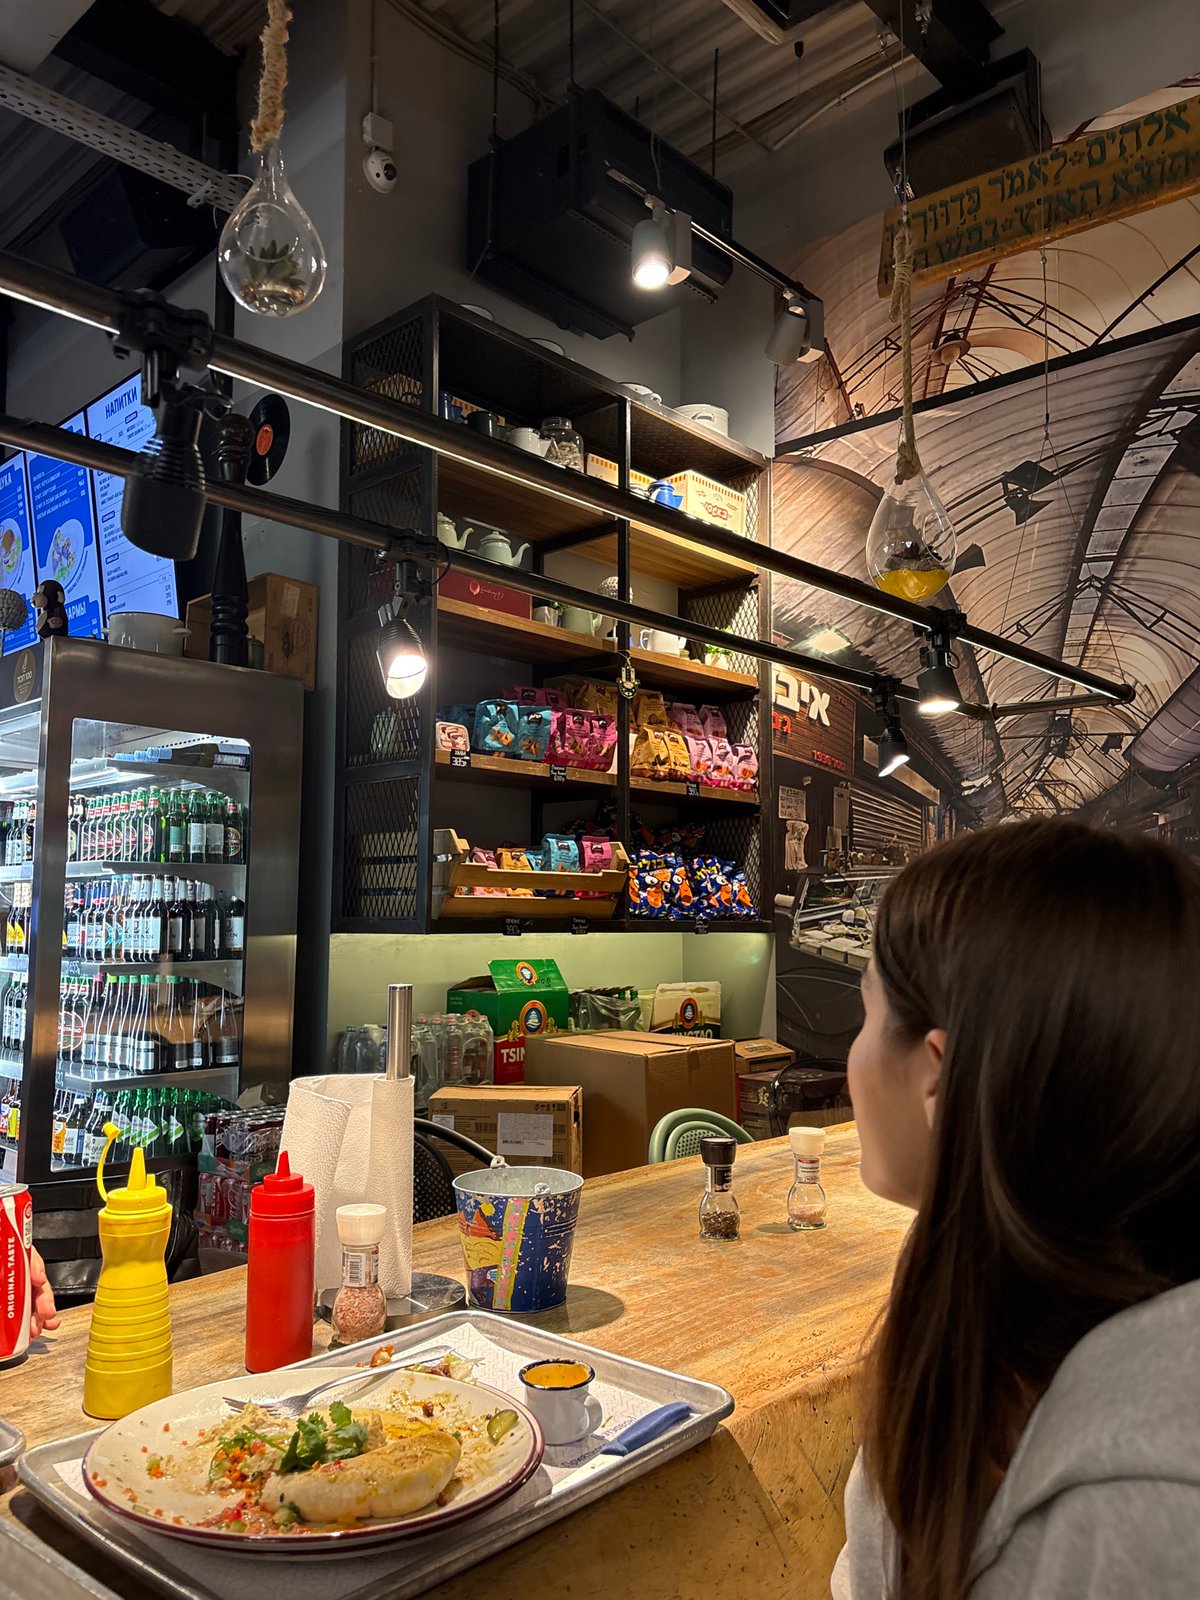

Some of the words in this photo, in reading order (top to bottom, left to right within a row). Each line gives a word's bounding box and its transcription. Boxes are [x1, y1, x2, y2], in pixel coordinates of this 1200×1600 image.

[105, 386, 138, 419] НАПИТКИ
[65, 601, 86, 620] АРМЫ
[7, 1236, 15, 1269] TASTE
[7, 1270, 15, 1319] ORIGINAL
